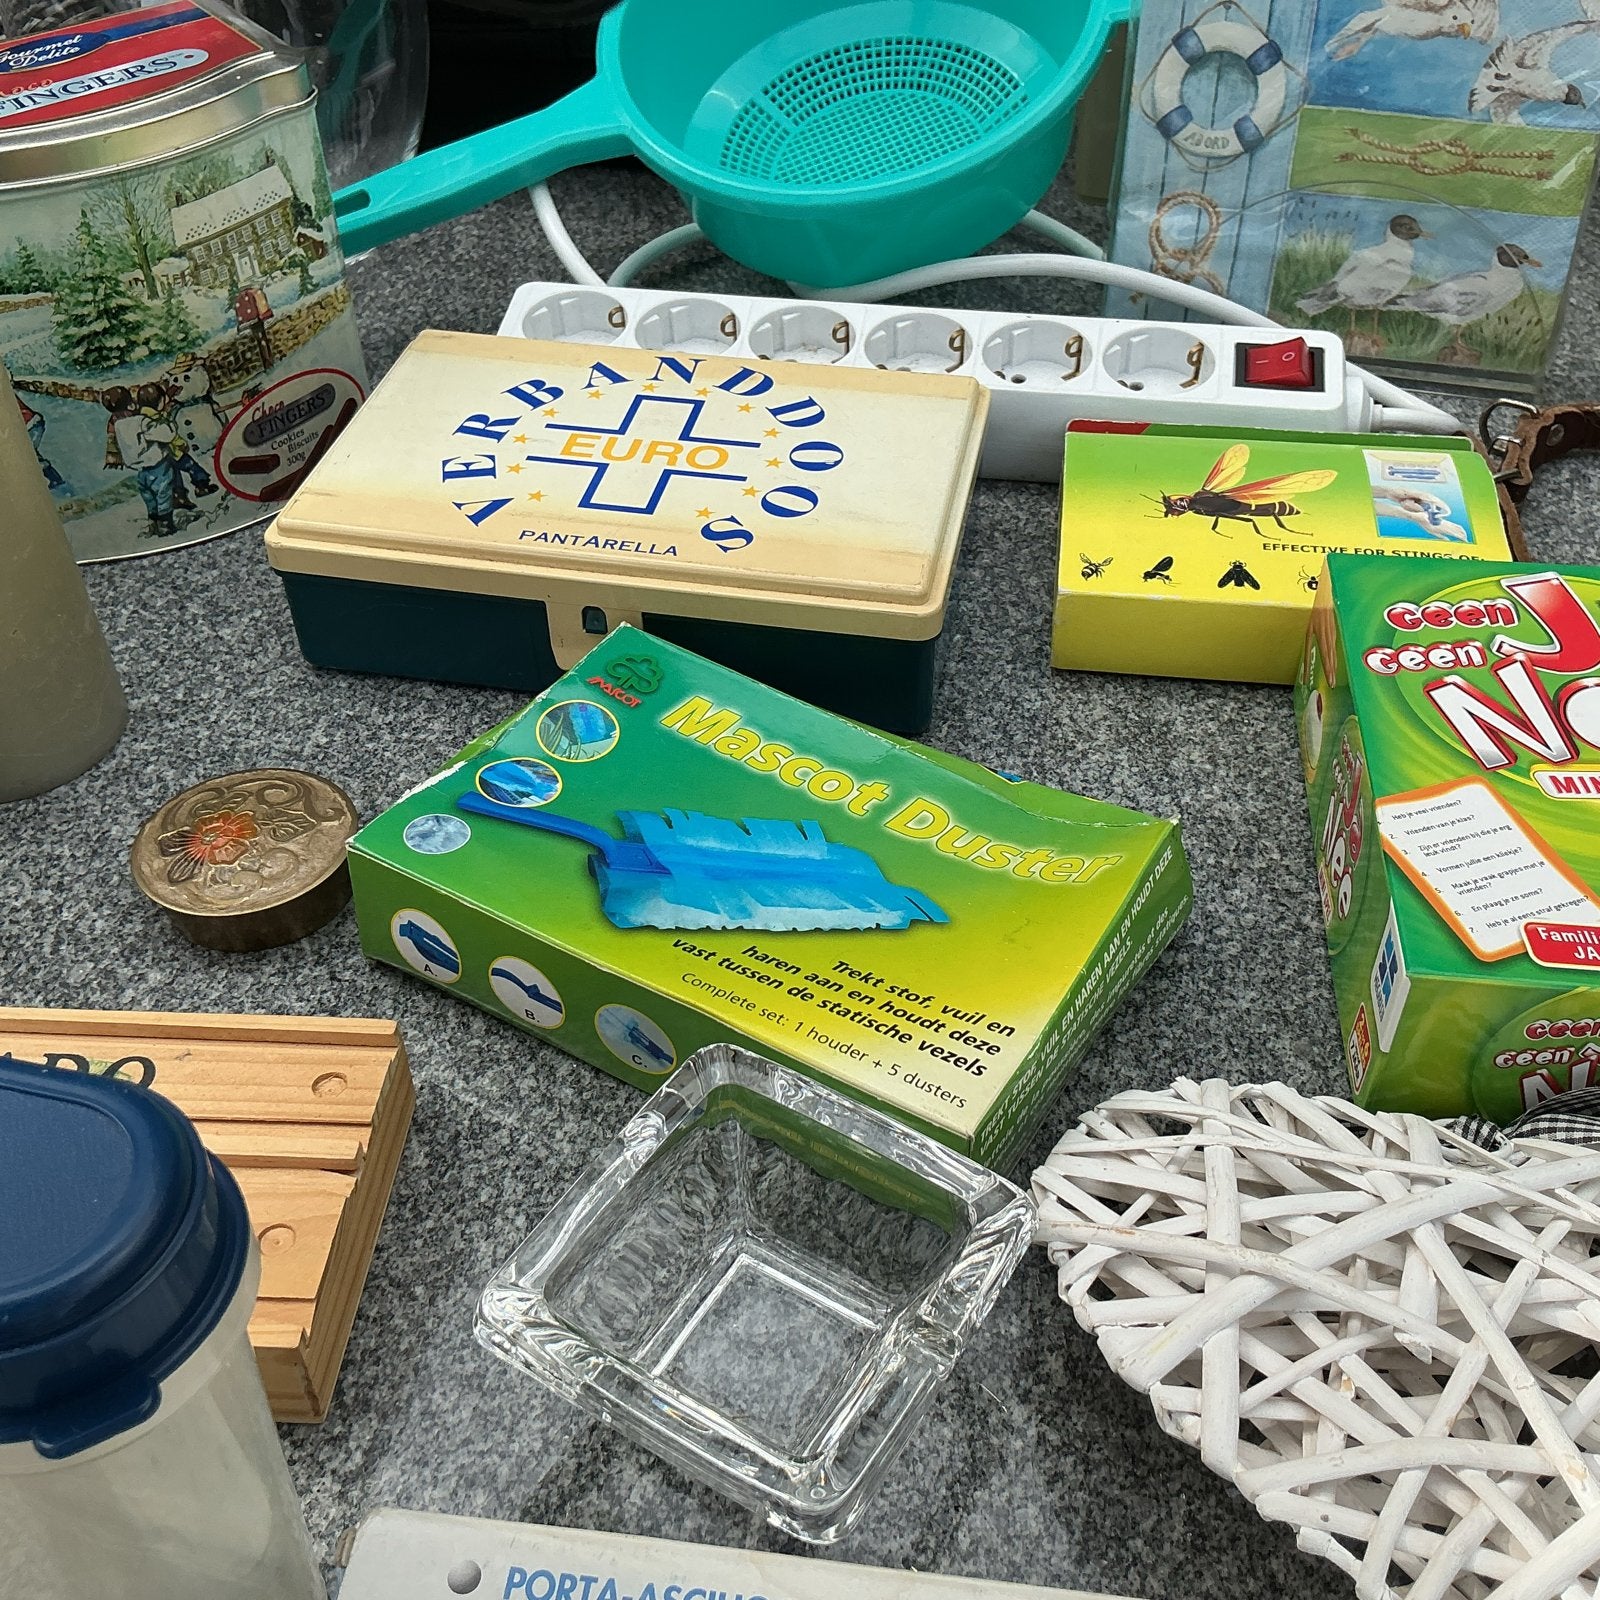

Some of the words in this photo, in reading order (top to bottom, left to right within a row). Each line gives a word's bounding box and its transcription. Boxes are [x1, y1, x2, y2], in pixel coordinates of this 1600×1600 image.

[9, 46, 81, 69] Delite
[0, 57, 178, 110] INGERS
[251, 400, 285, 423] Choco
[257, 392, 327, 439] FINGERS
[270, 427, 305, 451] Cookies
[287, 430, 320, 454] Biscuits
[441, 356, 844, 554] VERBANDDOOS
[559, 432, 730, 471] EURO
[286, 452, 307, 467] 300g
[518, 530, 678, 557] PANTARELLA
[1262, 543, 1348, 554] EFFECTIVE
[1353, 548, 1385, 556] FOR
[1384, 598, 1518, 631] Geen
[1362, 639, 1488, 676] Geen
[659, 696, 889, 817] Mascot
[884, 797, 1121, 884] Duster
[1536, 926, 1600, 945] Famili
[672, 938, 717, 962] vast
[718, 958, 784, 989] tussen
[787, 984, 815, 1003] de
[816, 998, 913, 1045] statische
[917, 1038, 988, 1078] vezels
[741, 945, 801, 976] haren
[803, 973, 844, 993] aan
[848, 989, 875, 1006] en
[877, 1001, 947, 1034] houdt
[949, 1029, 1002, 1057] deze
[831, 960, 884, 988] Trekt
[885, 980, 935, 1010] stof,
[940, 1004, 984, 1027] vuil
[986, 1021, 1016, 1038] en
[981, 1095, 1011, 1142] TREKT
[1041, 1029, 1060, 1061] VUIL
[1061, 1006, 1074, 1030] EN
[1075, 963, 1102, 1011] HAREN
[1103, 933, 1120, 967] AAN
[1121, 914, 1131, 939] EN
[1131, 878, 1156, 920] HOUDT
[1154, 845, 1174, 880] DEZE
[524, 1008, 540, 1023] B.
[681, 972, 757, 1012] Complete
[758, 1007, 790, 1027] set:
[794, 1020, 804, 1032] 1
[806, 1026, 869, 1062] houder
[872, 1058, 883, 1070] +
[887, 1063, 900, 1077] 5
[903, 1071, 968, 1110] dusters
[1494, 1046, 1576, 1069] Geen
[631, 1054, 648, 1068] C.
[980, 1116, 1006, 1156] VAST
[1008, 1065, 1044, 1119] TUSSEN
[1046, 1046, 1060, 1069] DE
[1061, 980, 1105, 1049] STATISCHE
